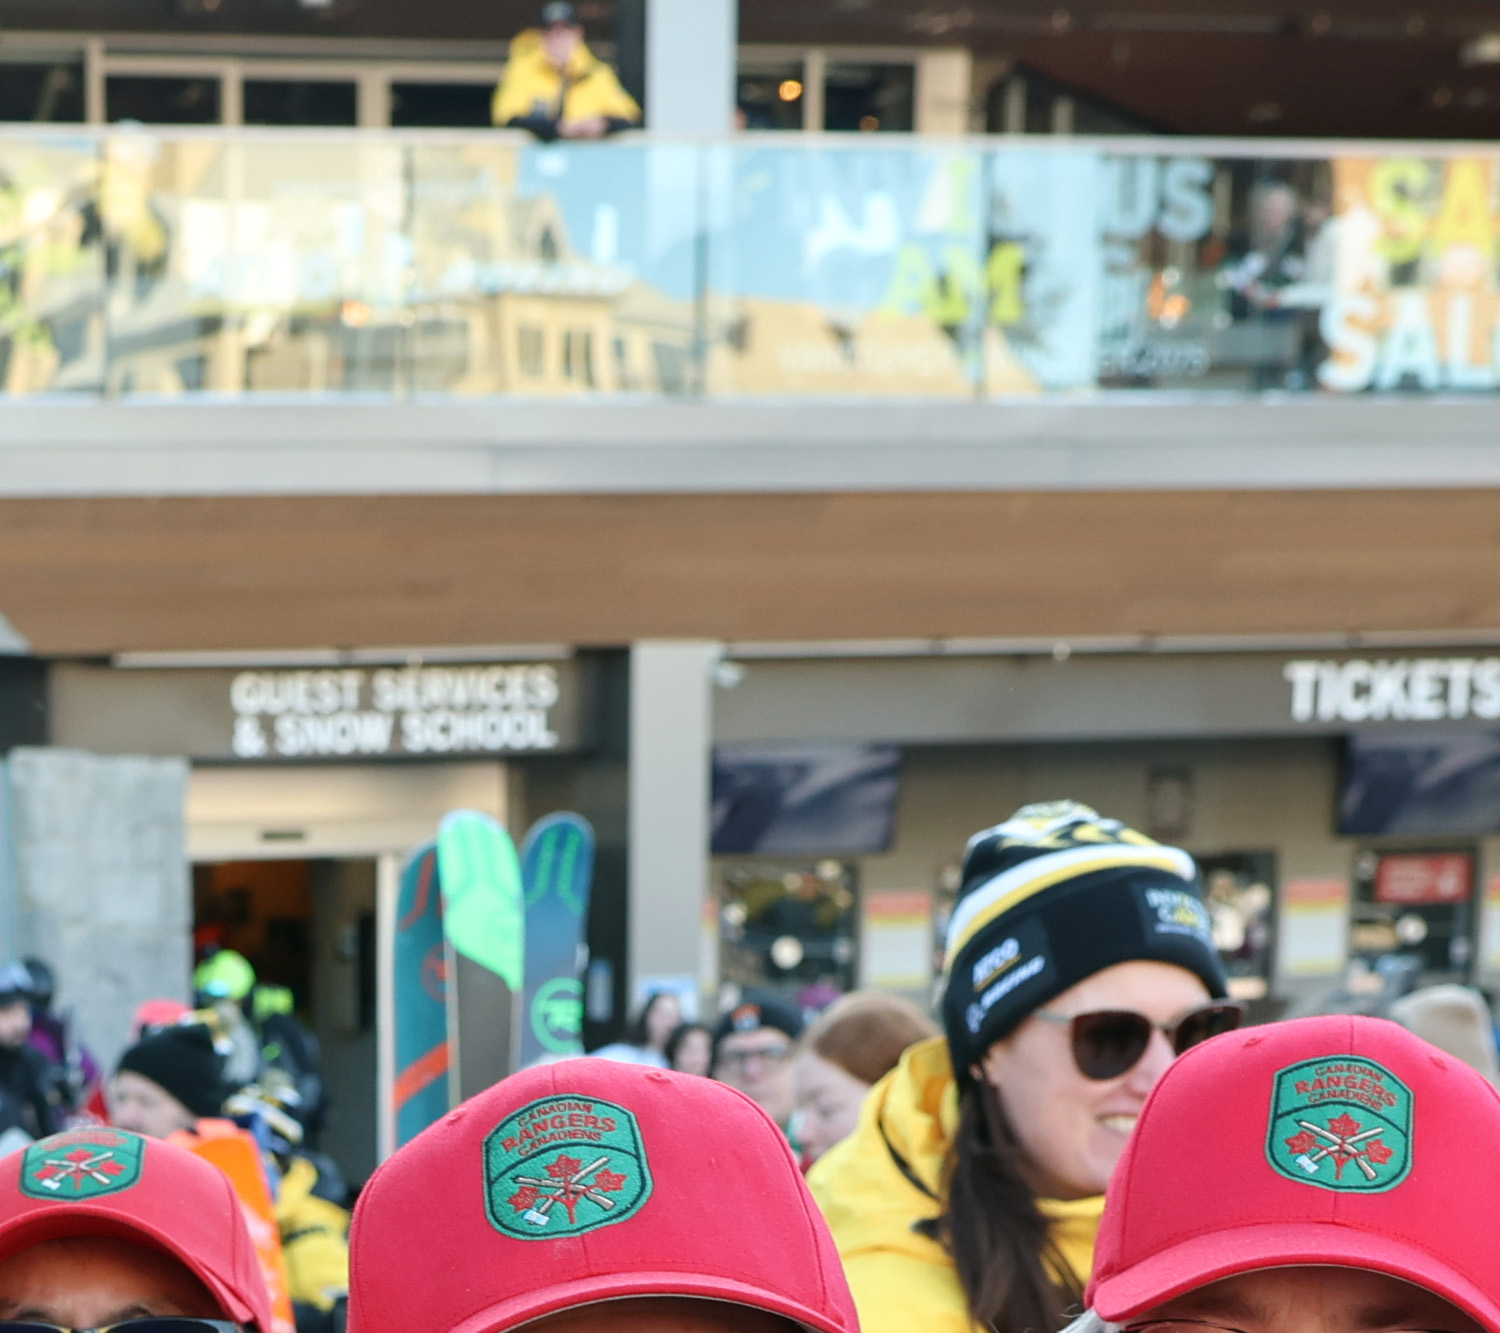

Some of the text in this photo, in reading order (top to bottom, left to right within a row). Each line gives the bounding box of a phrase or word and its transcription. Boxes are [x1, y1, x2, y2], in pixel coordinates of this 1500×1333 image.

[230, 663, 560, 715] GUEST SERVICES
[232, 708, 560, 758] & SNOW SCHOOL
[1294, 1075, 1398, 1107] RANGERS
[500, 1112, 618, 1152] RANGERS
[517, 1101, 594, 1128] CANADIAN
[517, 1129, 603, 1157] CANADIENS
